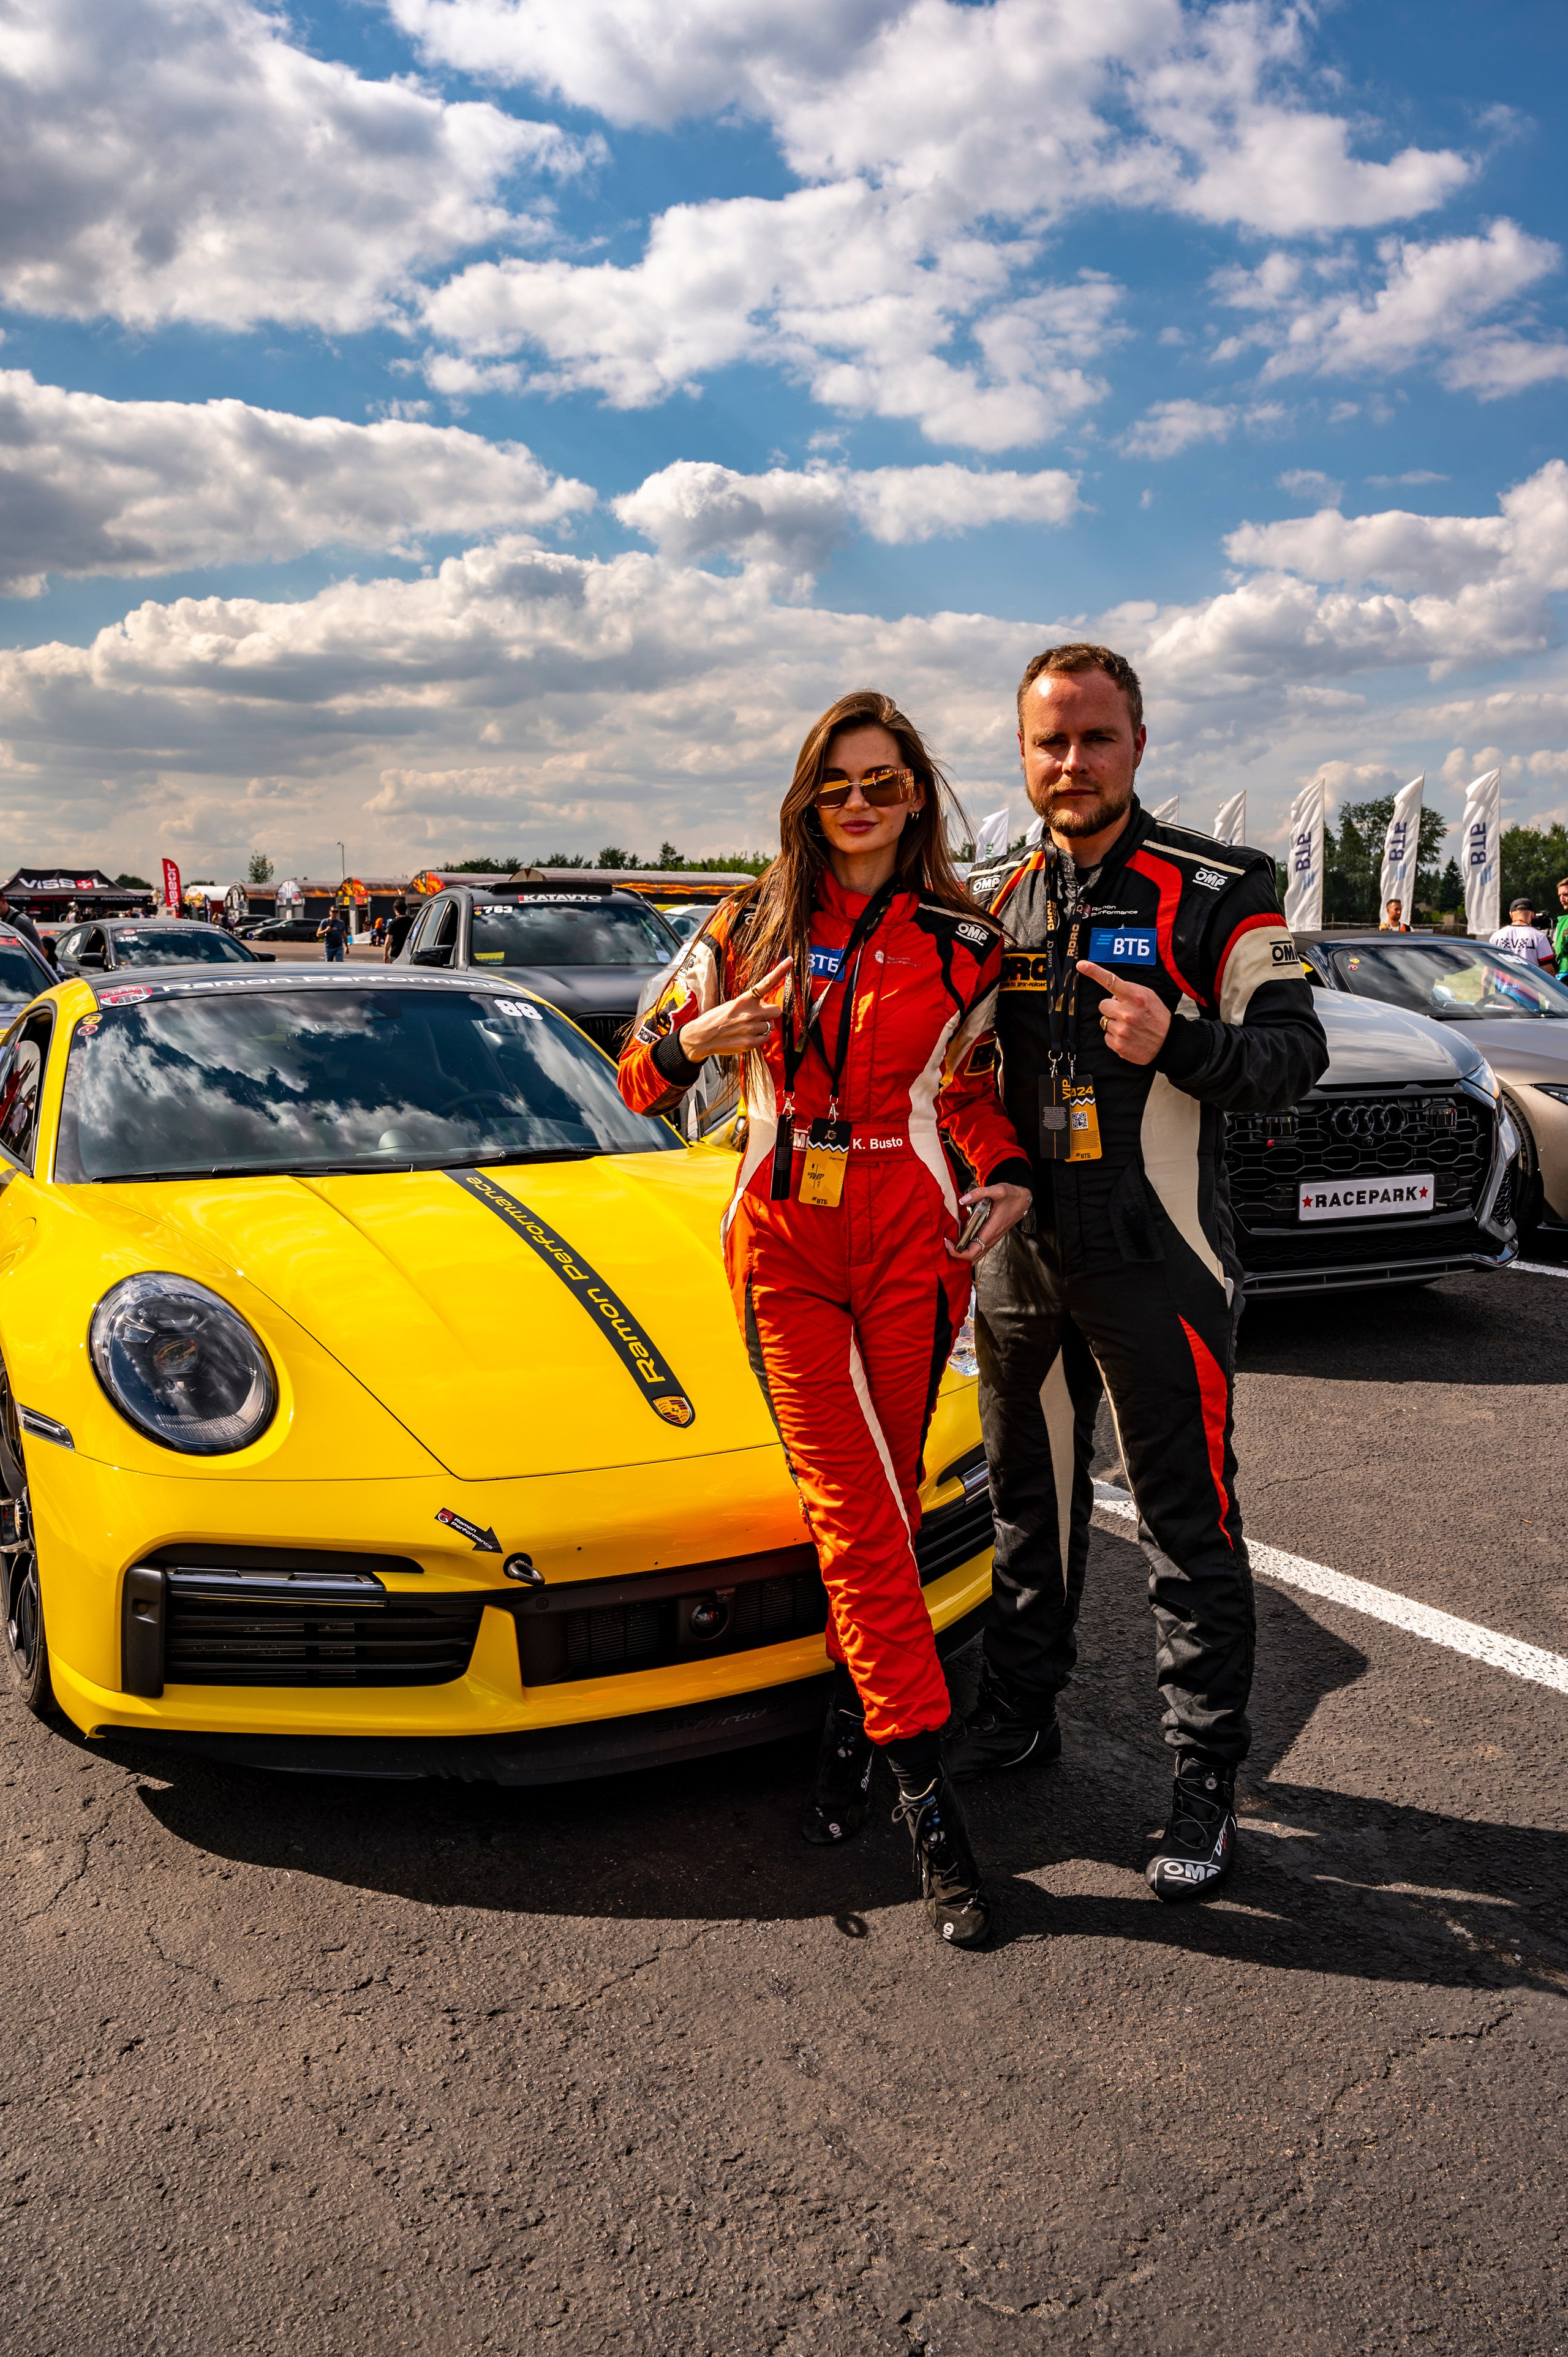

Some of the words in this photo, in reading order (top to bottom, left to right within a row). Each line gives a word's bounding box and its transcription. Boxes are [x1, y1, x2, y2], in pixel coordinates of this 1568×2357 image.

[973, 877, 1000, 892] OMP
[1195, 870, 1226, 887] OMP
[957, 923, 987, 941] OMP
[1066, 924, 1080, 957] RDRC
[1113, 938, 1150, 956] ВТБ
[807, 953, 840, 973] ВТБ
[162, 977, 293, 992] Ramon
[303, 975, 524, 994] Performance
[494, 999, 543, 1020] 88
[1062, 1079, 1071, 1100] VIP
[853, 1138, 865, 1150] K.
[870, 1136, 903, 1150] Busto
[1314, 1186, 1418, 1209] RACEPARK
[465, 1175, 589, 1281] Performance
[587, 1287, 665, 1384] Ramon
[453, 1517, 477, 1533] Ramon
[450, 1521, 493, 1550] Performance
